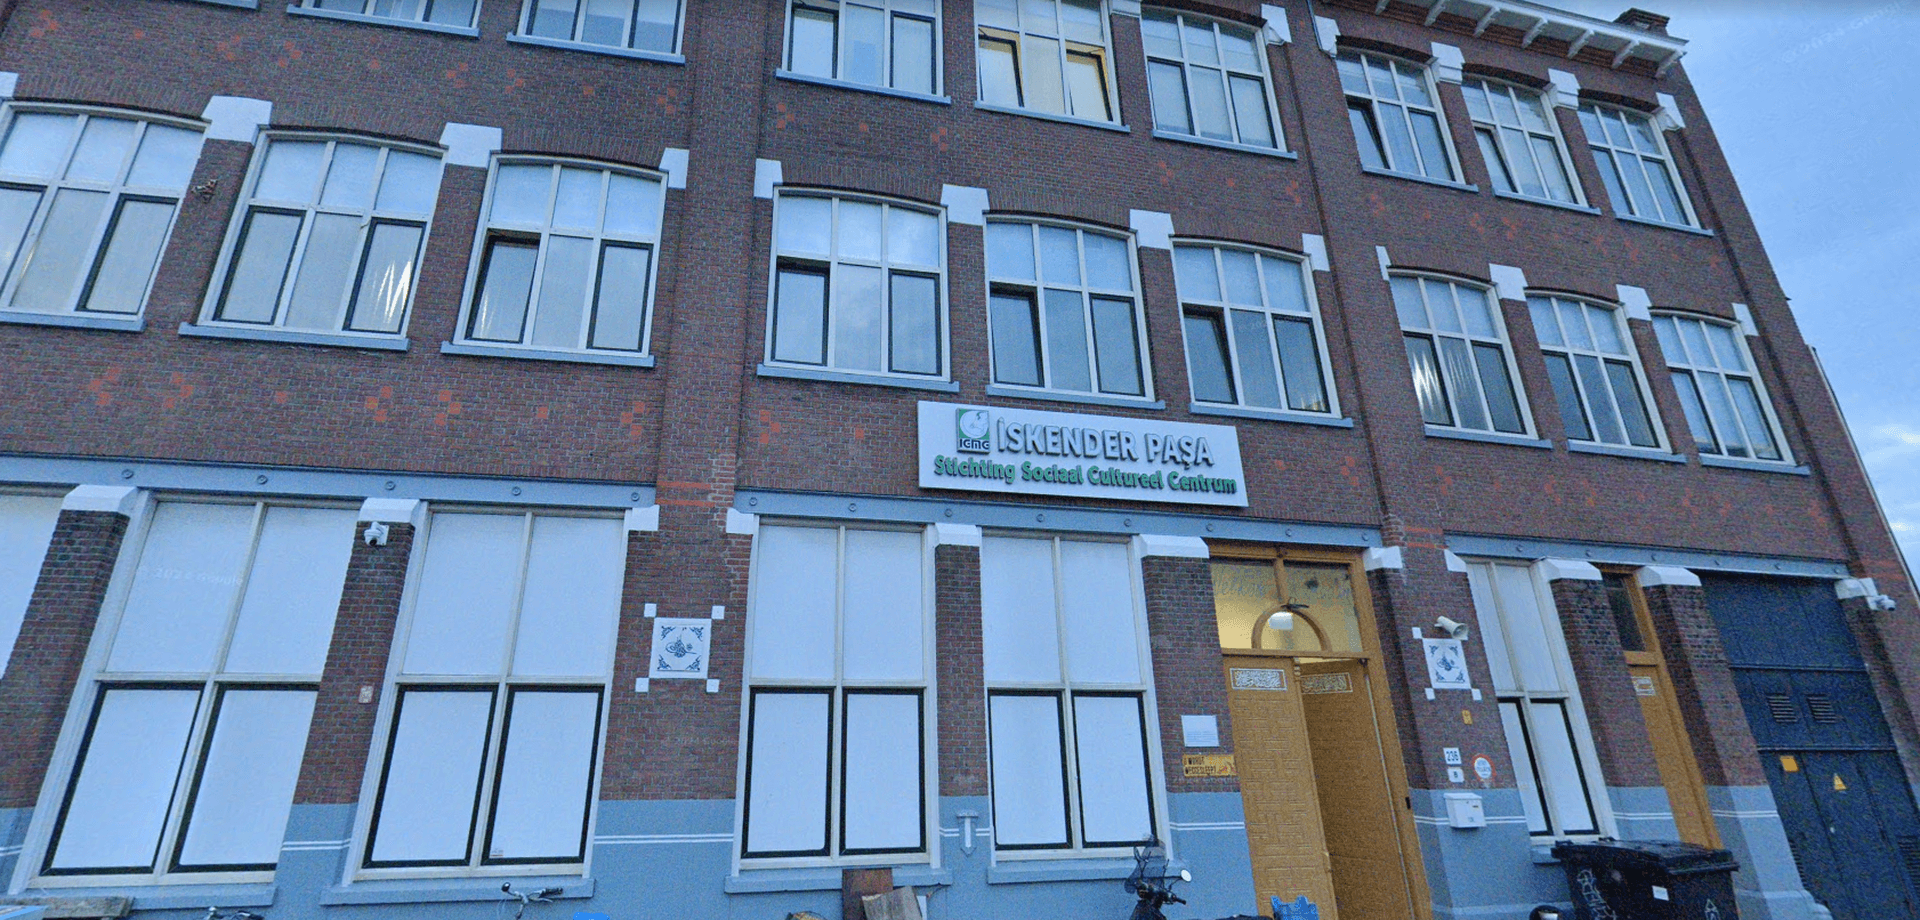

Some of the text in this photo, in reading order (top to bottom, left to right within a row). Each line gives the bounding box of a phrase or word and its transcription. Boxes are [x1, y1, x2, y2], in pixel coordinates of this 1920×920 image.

[959, 438, 990, 450] IGMG
[997, 417, 1215, 470] İSKENDER PAŞA
[934, 455, 1237, 494] Stichting Sociaal Cultureel Centrum
[1445, 750, 1459, 762] 236
